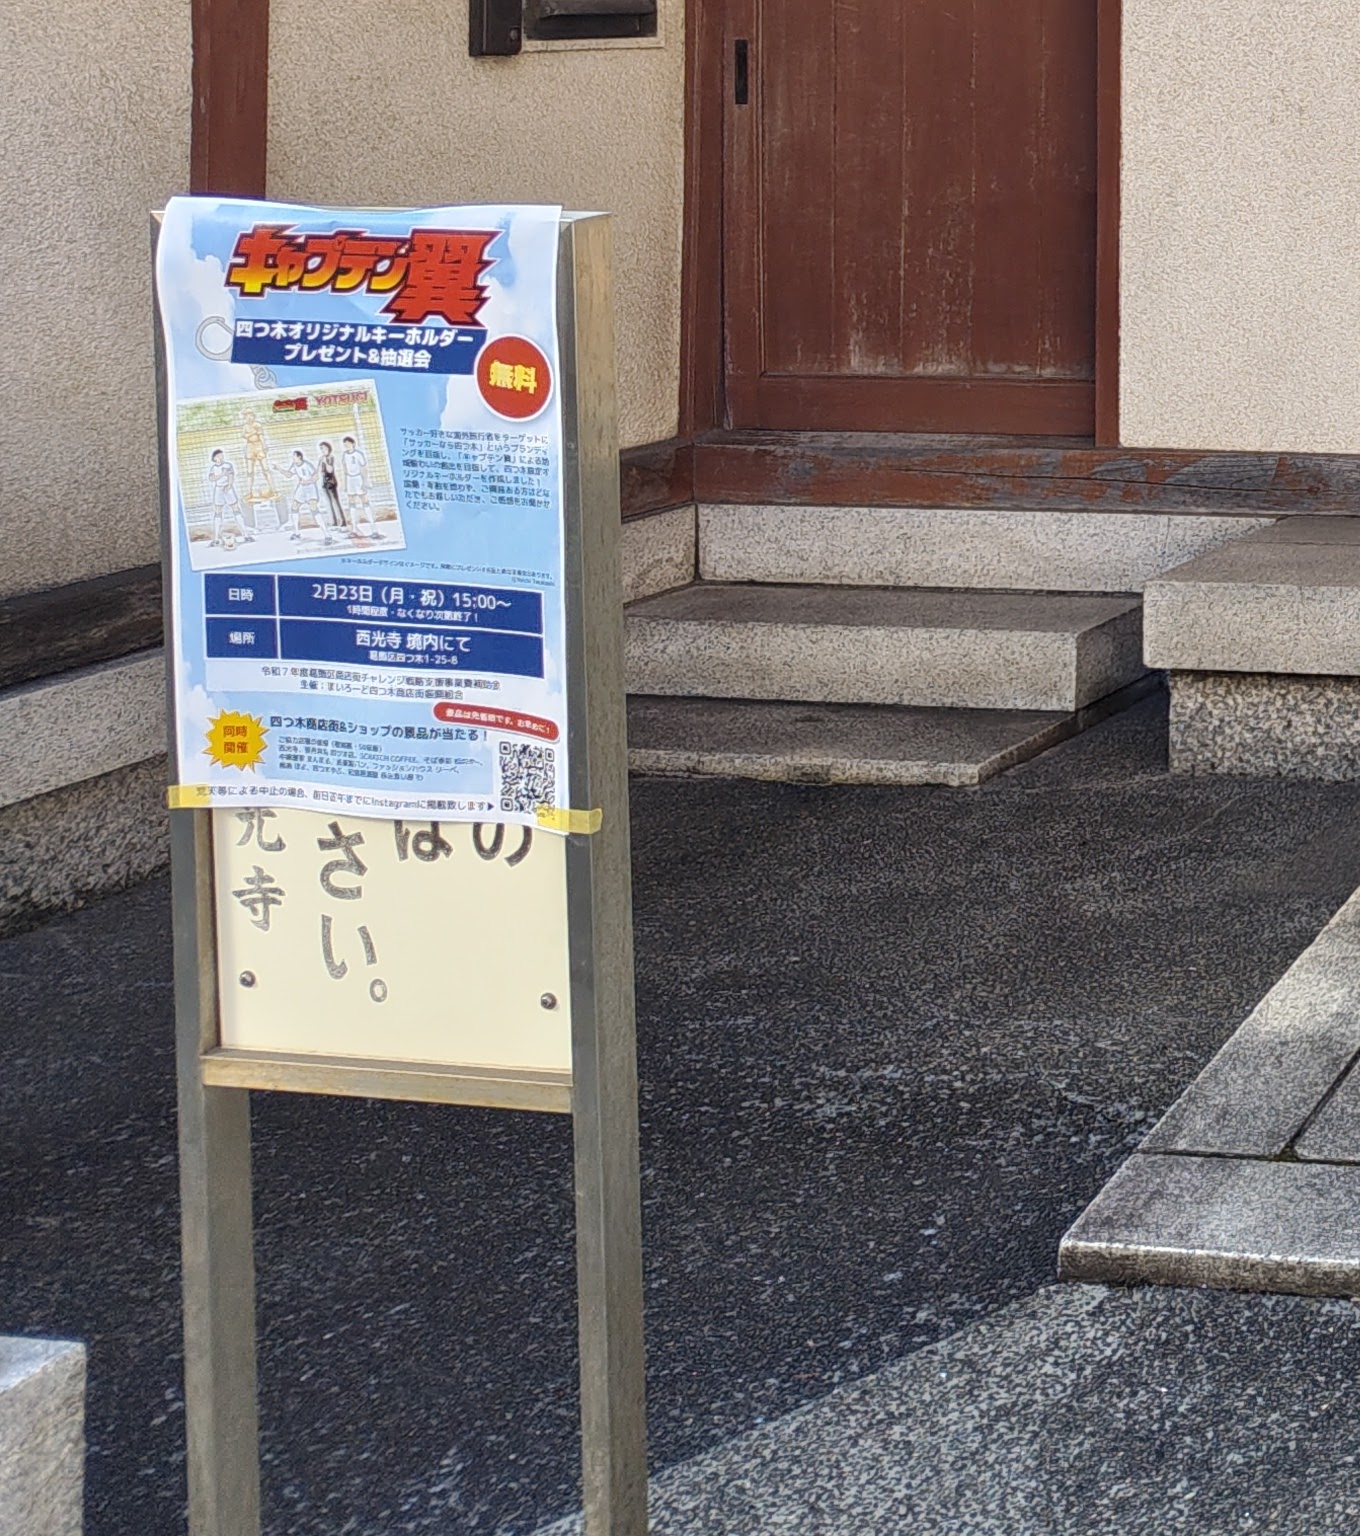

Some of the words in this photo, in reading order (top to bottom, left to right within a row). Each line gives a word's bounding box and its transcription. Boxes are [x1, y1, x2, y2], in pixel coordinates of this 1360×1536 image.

[226, 225, 501, 326] キャプテン翼
[236, 321, 473, 347] 四つ木オリジナルキーホルダー
[489, 360, 538, 394] 無料
[229, 588, 253, 601] 日時
[229, 631, 255, 644] 場所
[356, 630, 401, 649] 西光寺
[406, 632, 471, 652] 境内にて
[369, 650, 458, 665] 葛飾区四つ木1-25-8
[223, 726, 247, 737] 同時
[224, 742, 248, 753] 開催
[317, 821, 388, 1003] さい。
